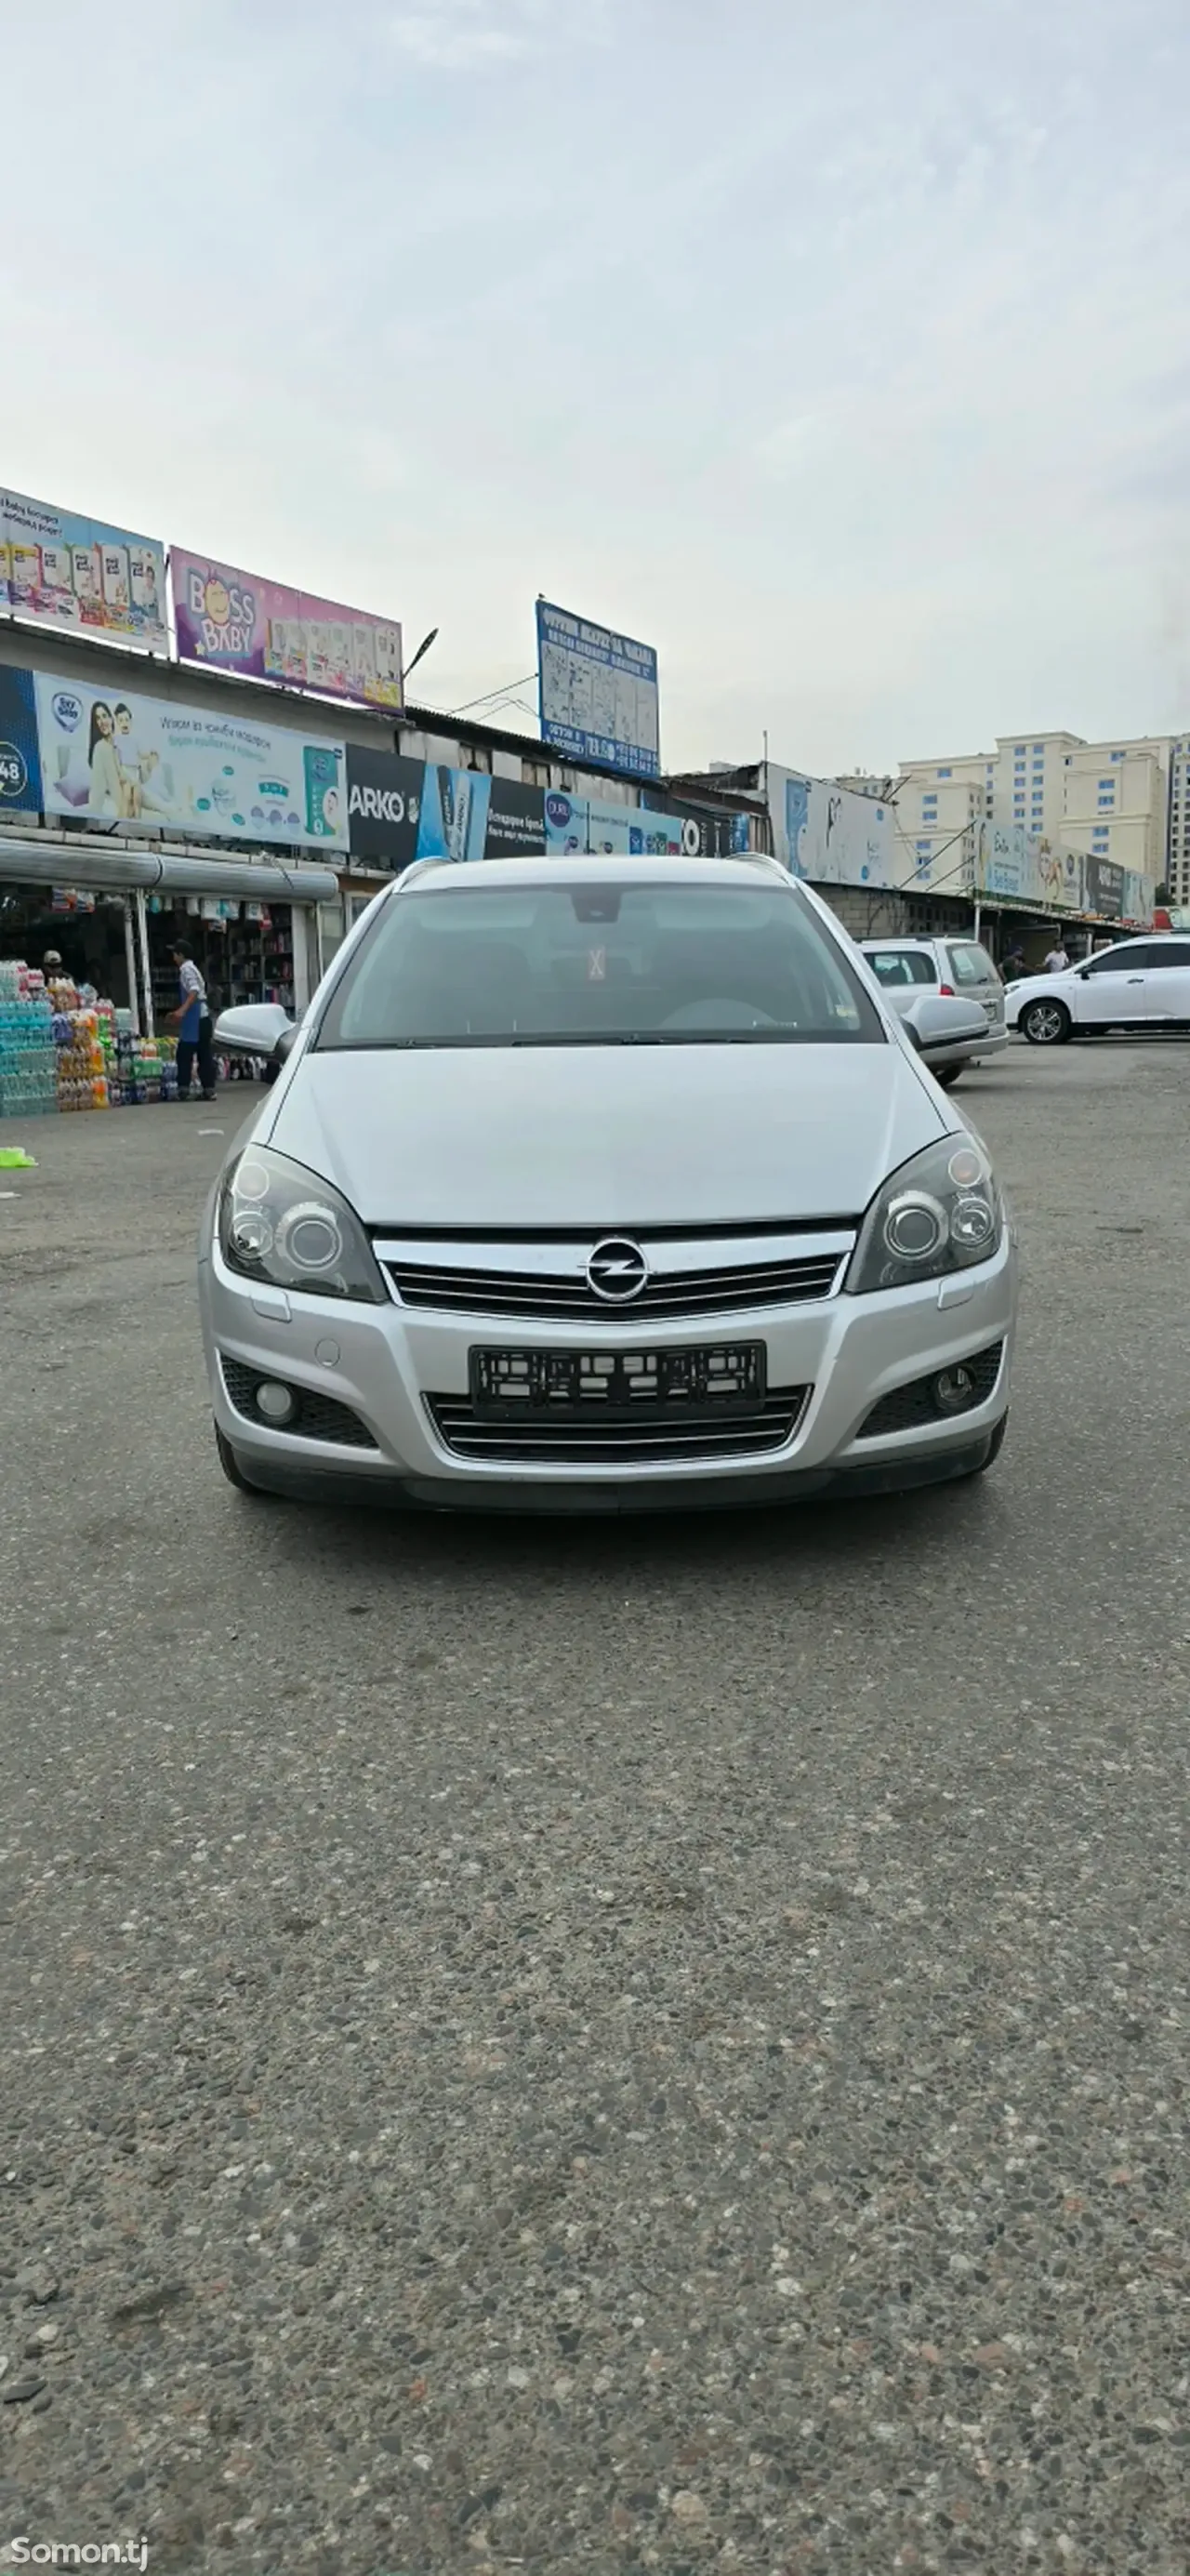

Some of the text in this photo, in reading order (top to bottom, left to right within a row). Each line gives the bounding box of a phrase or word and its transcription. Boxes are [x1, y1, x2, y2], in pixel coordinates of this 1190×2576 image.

[190, 573, 254, 625] BOSS
[201, 617, 250, 652] BABY
[349, 784, 404, 823] ARKO
